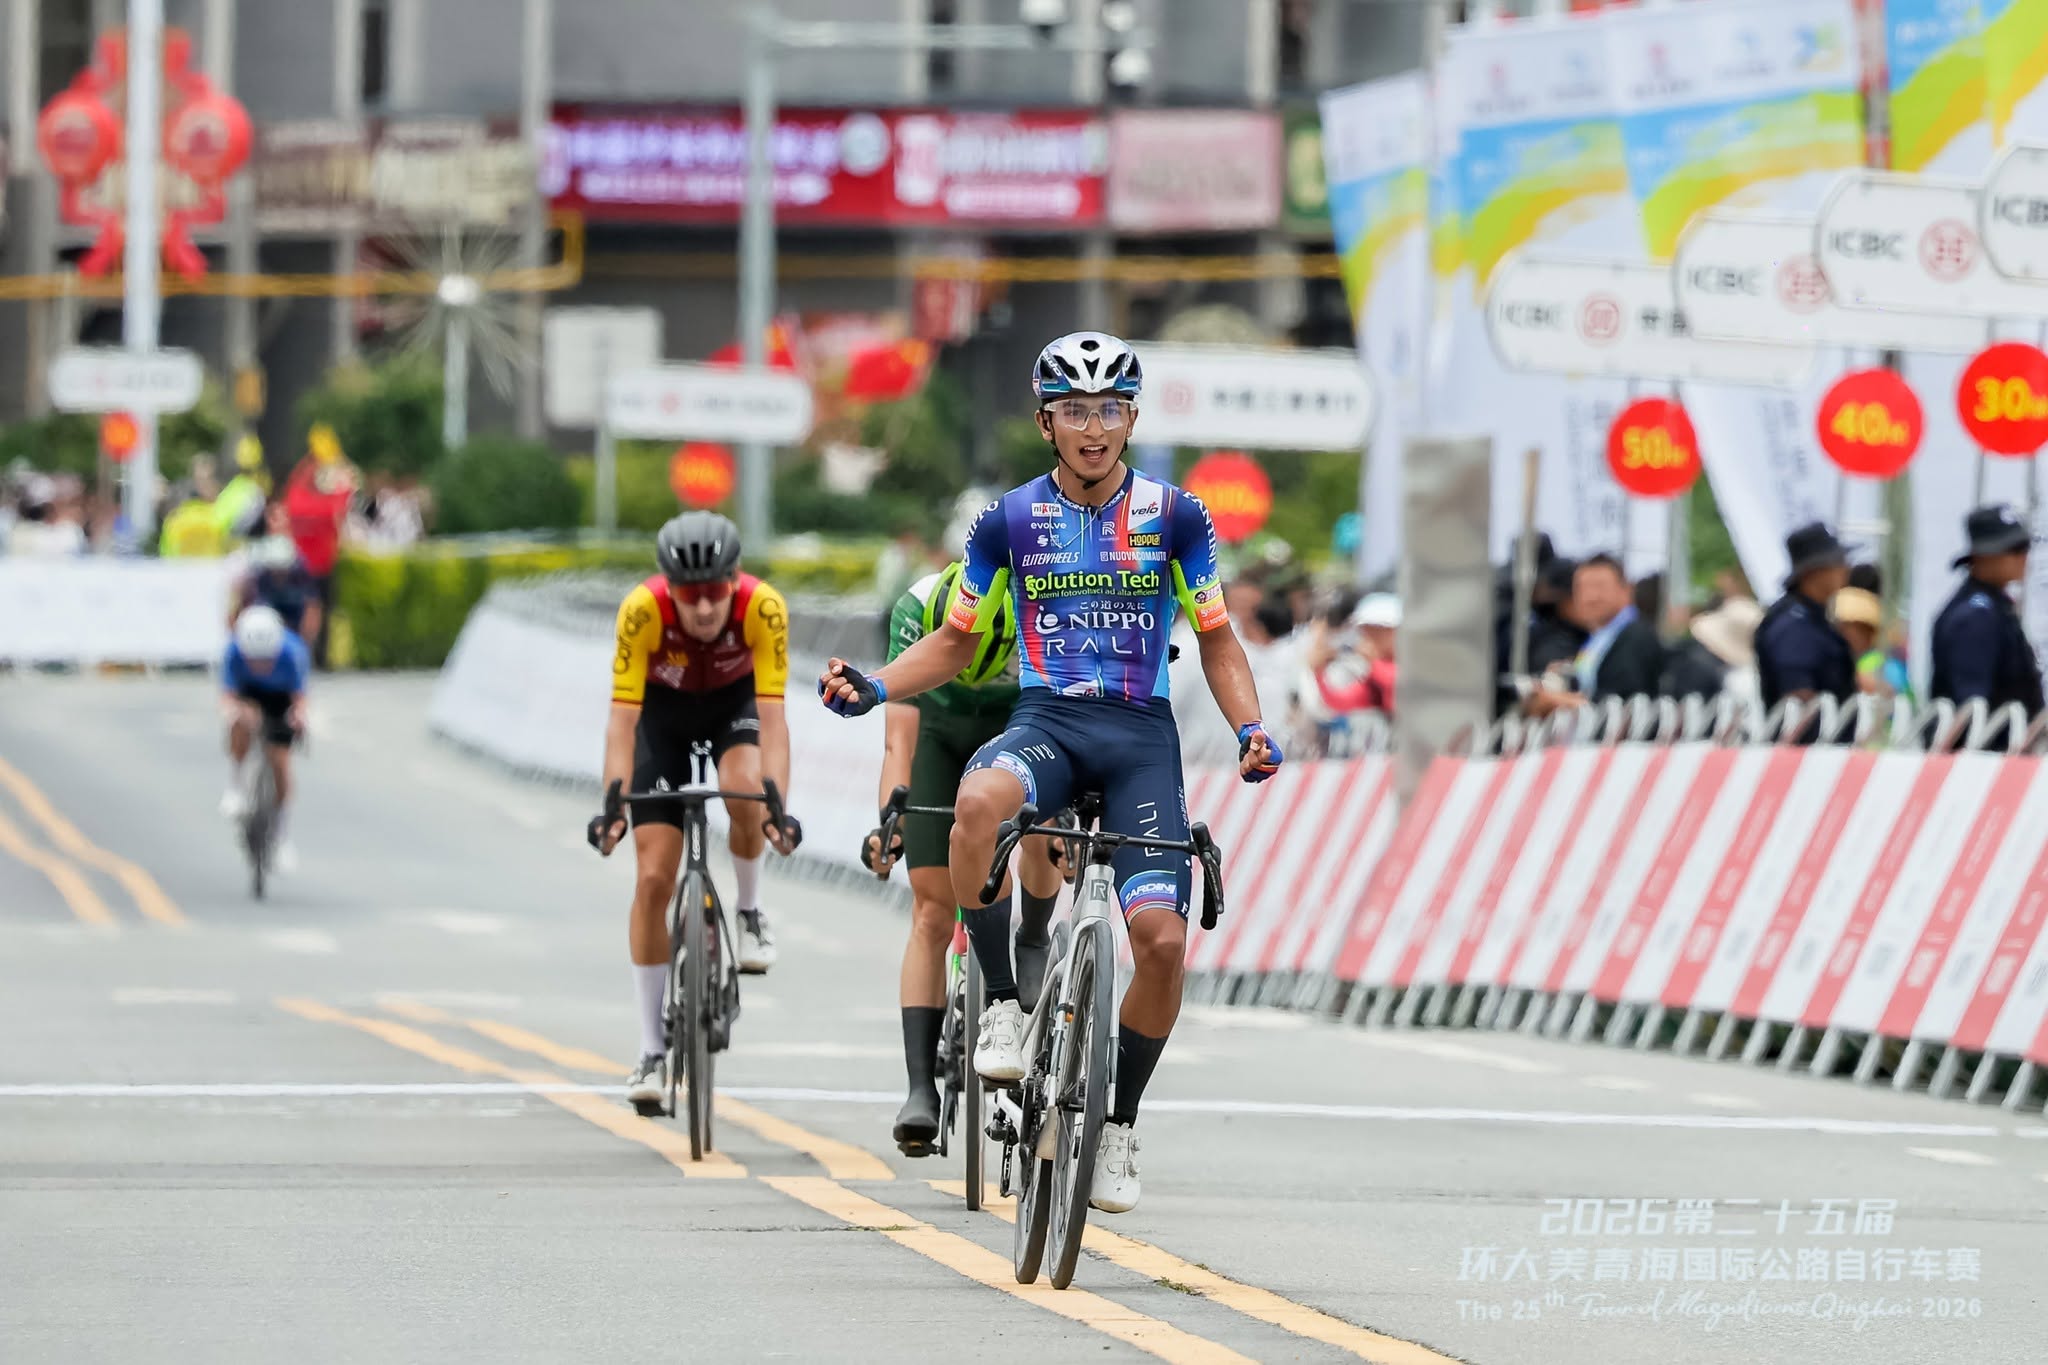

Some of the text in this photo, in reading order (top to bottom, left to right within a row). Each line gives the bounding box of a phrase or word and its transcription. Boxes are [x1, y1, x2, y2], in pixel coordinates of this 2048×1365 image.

[1021, 551, 1081, 568] ELITEWHEELS
[1024, 570, 1160, 600] Solution Tech
[1104, 588, 1116, 596] ad
[1079, 600, 1146, 611] この道の先に
[1068, 611, 1155, 631] NIPPO
[1046, 636, 1147, 657] RALI
